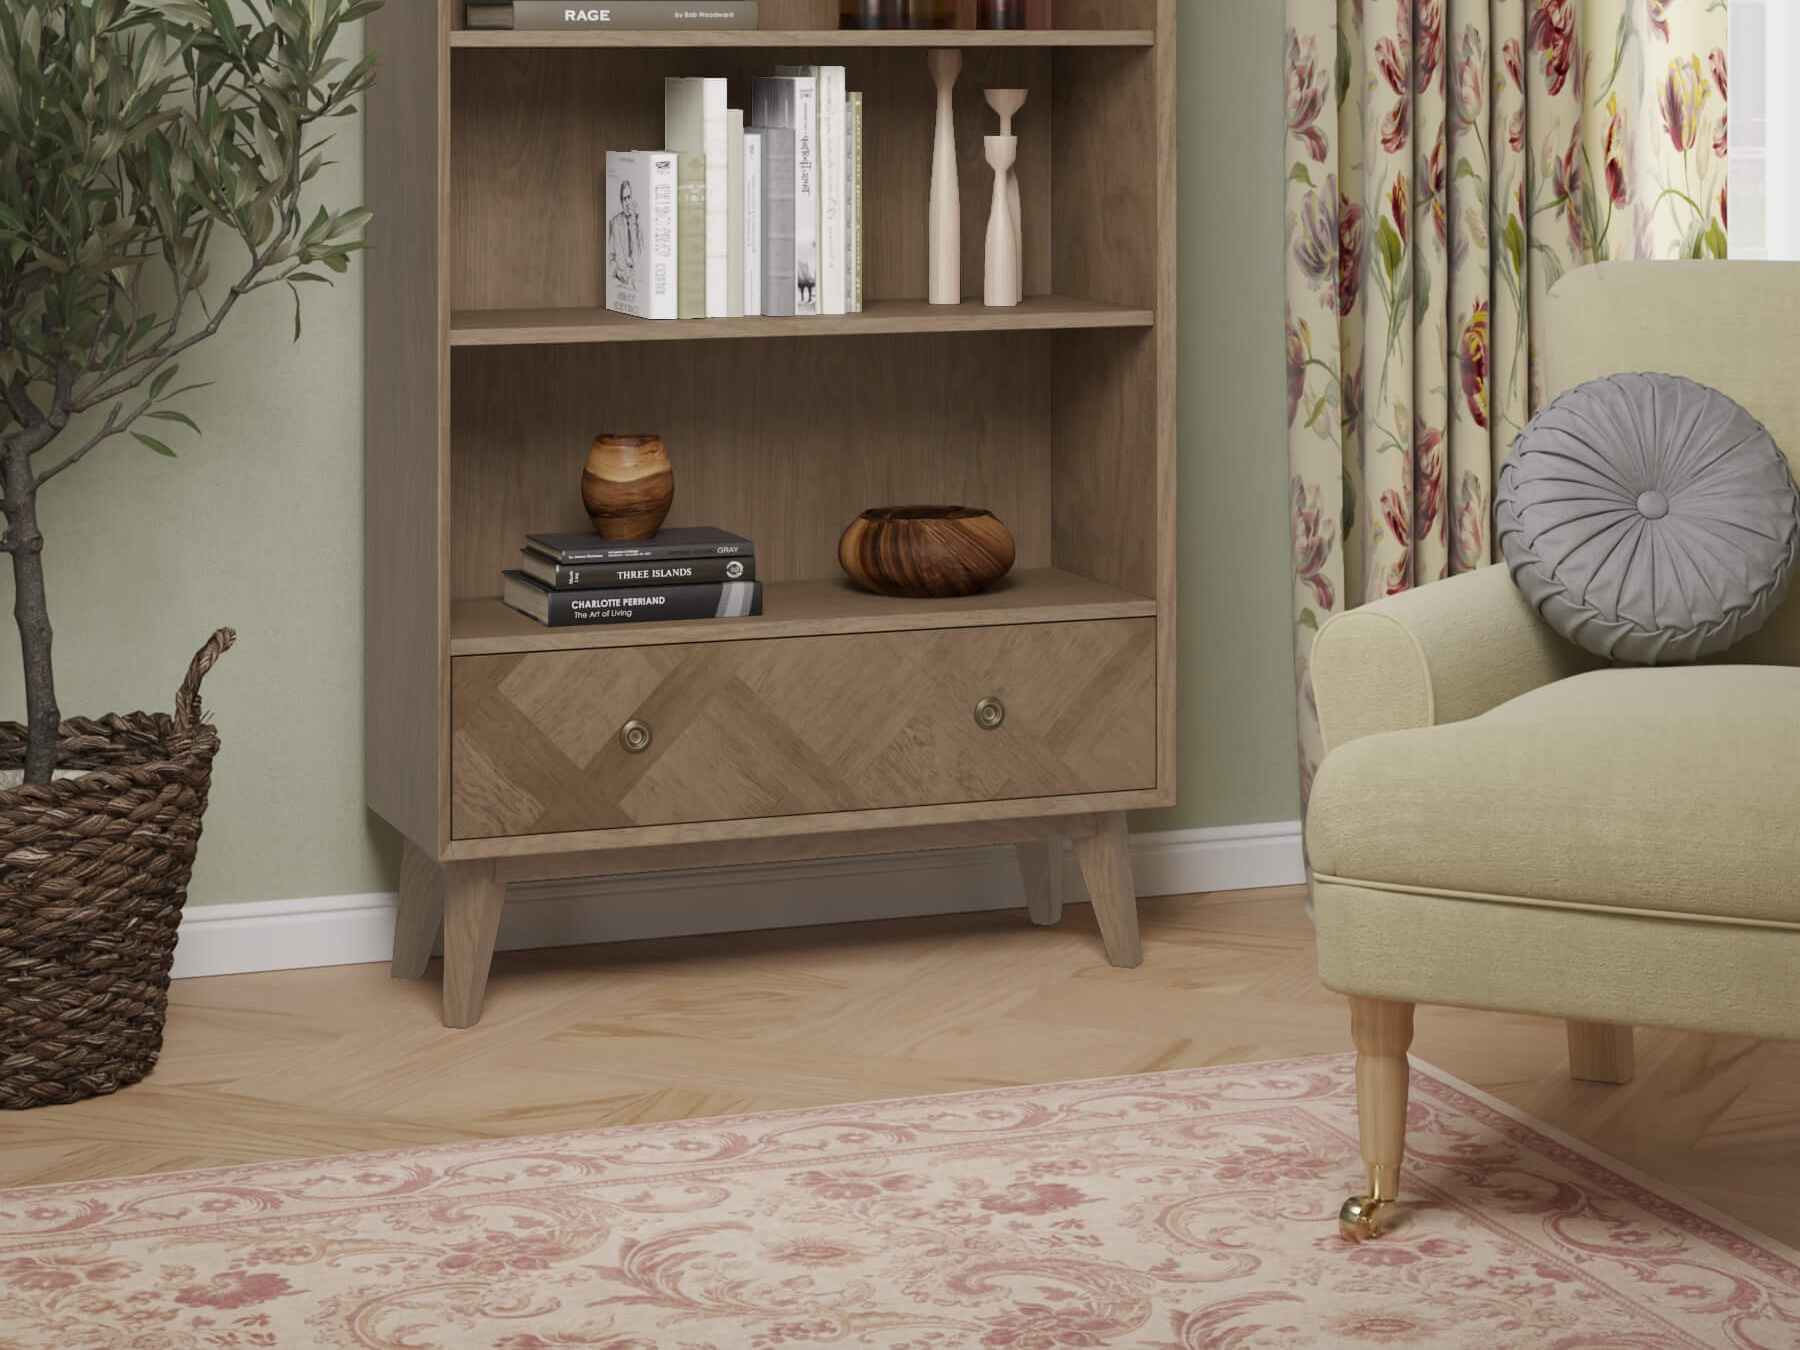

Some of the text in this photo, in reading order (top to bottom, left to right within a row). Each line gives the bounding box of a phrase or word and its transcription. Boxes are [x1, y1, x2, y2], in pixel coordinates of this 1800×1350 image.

[564, 9, 611, 22] RAGE
[716, 546, 739, 555] GRAY
[616, 567, 692, 580] THREE ISLANDS
[571, 595, 666, 610] CHARLOTTE PERRIAND
[574, 609, 633, 619] The Art of Living
